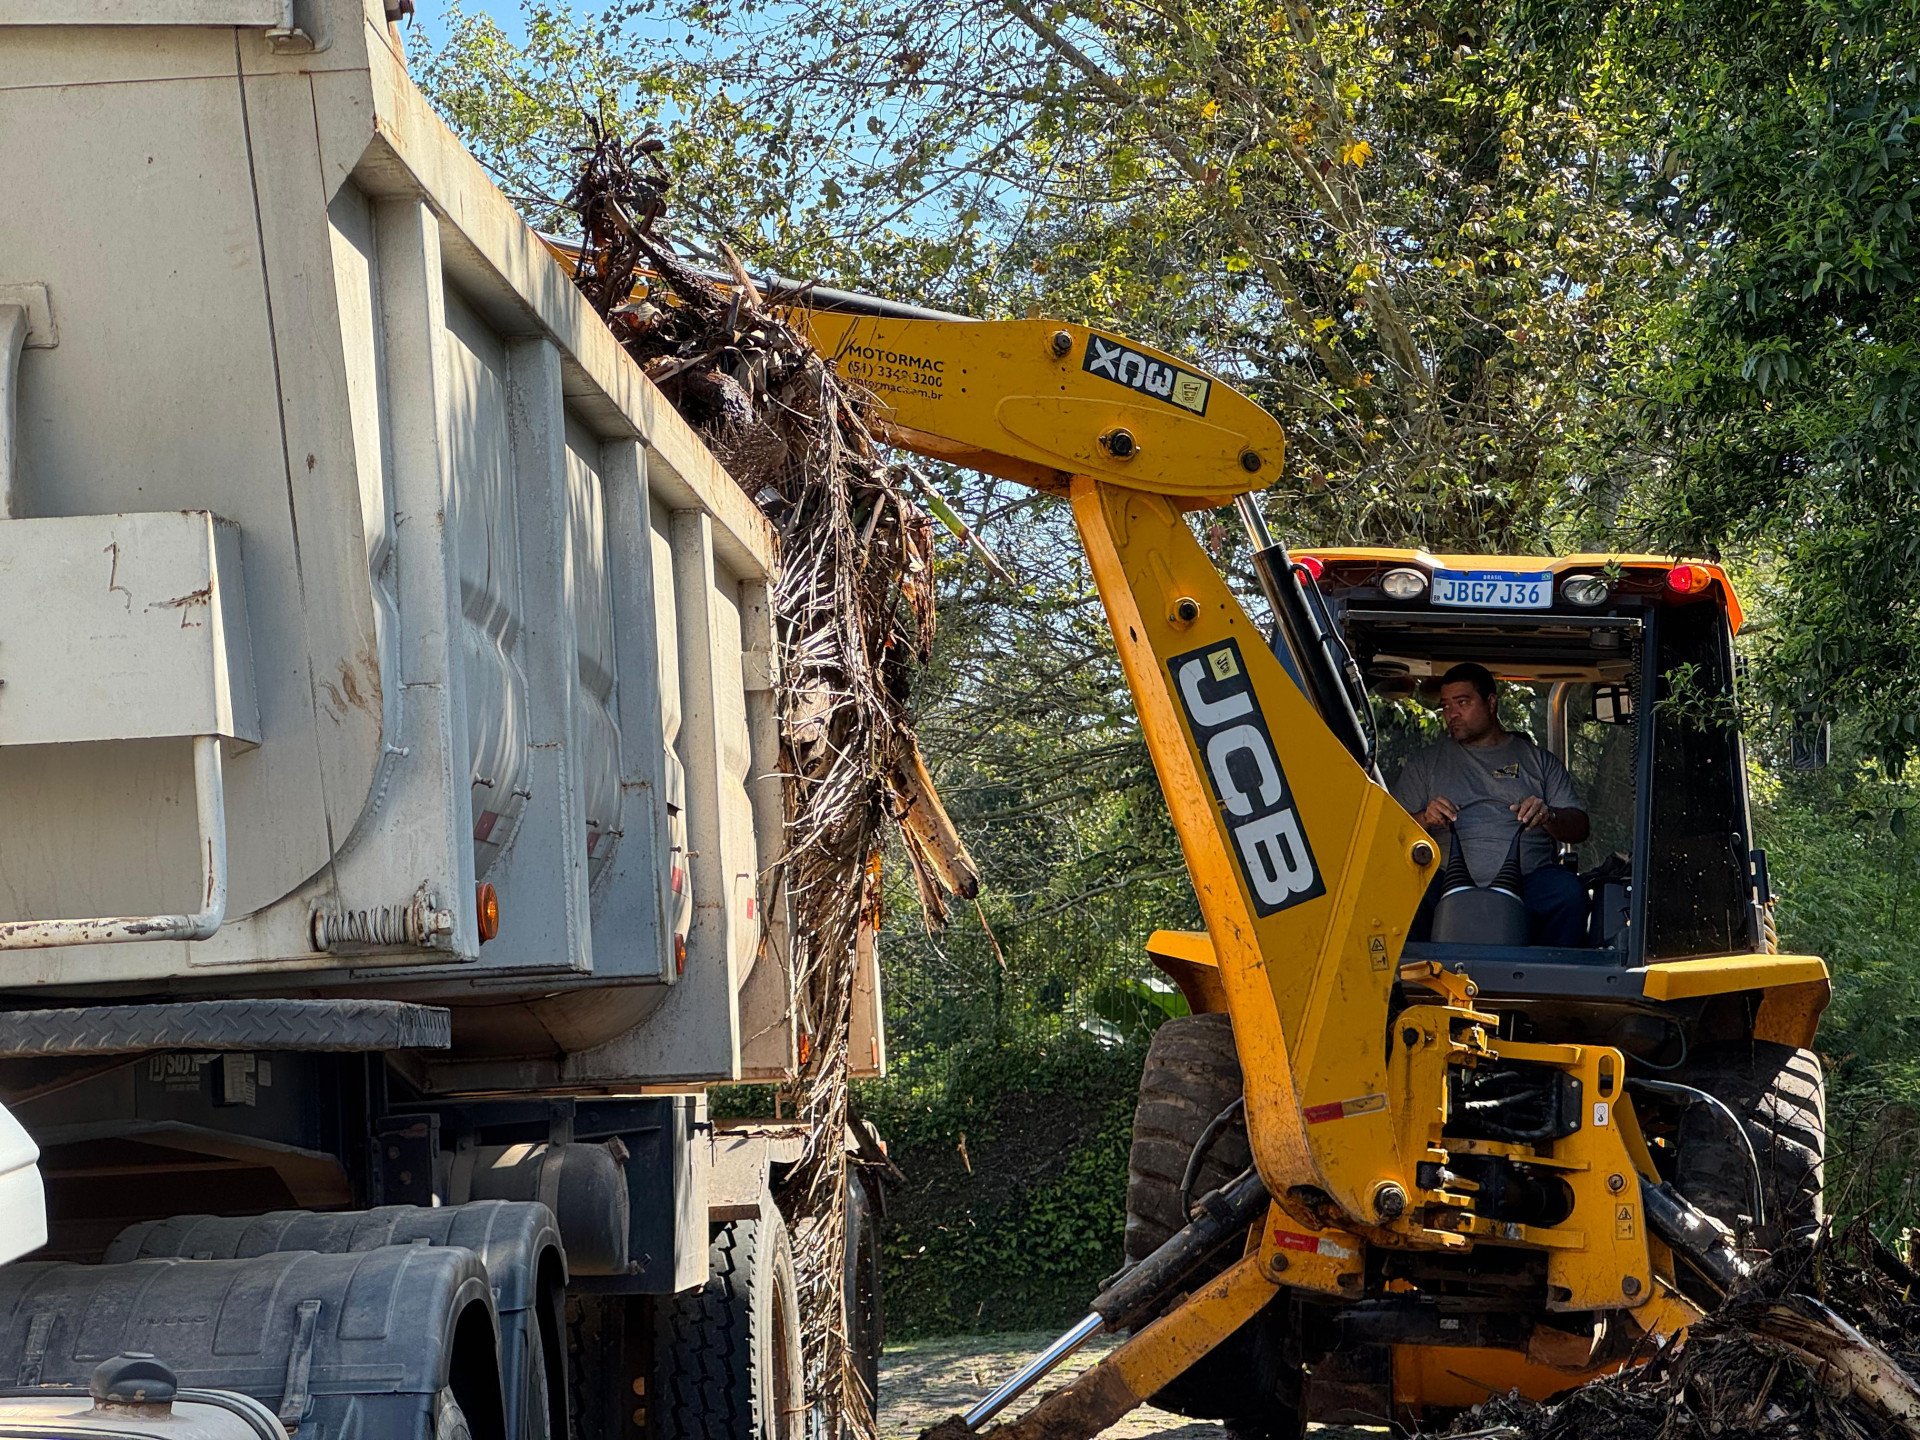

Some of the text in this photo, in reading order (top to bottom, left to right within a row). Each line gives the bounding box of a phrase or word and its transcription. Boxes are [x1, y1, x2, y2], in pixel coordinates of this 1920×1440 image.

[848, 345, 944, 373] MOTORMAC
[848, 360, 873, 377] (51)
[1090, 337, 1173, 396] 3CX
[1182, 383, 1199, 401] JCB
[1444, 581, 1540, 604] JBG7J36
[1178, 658, 1314, 906] JCB
